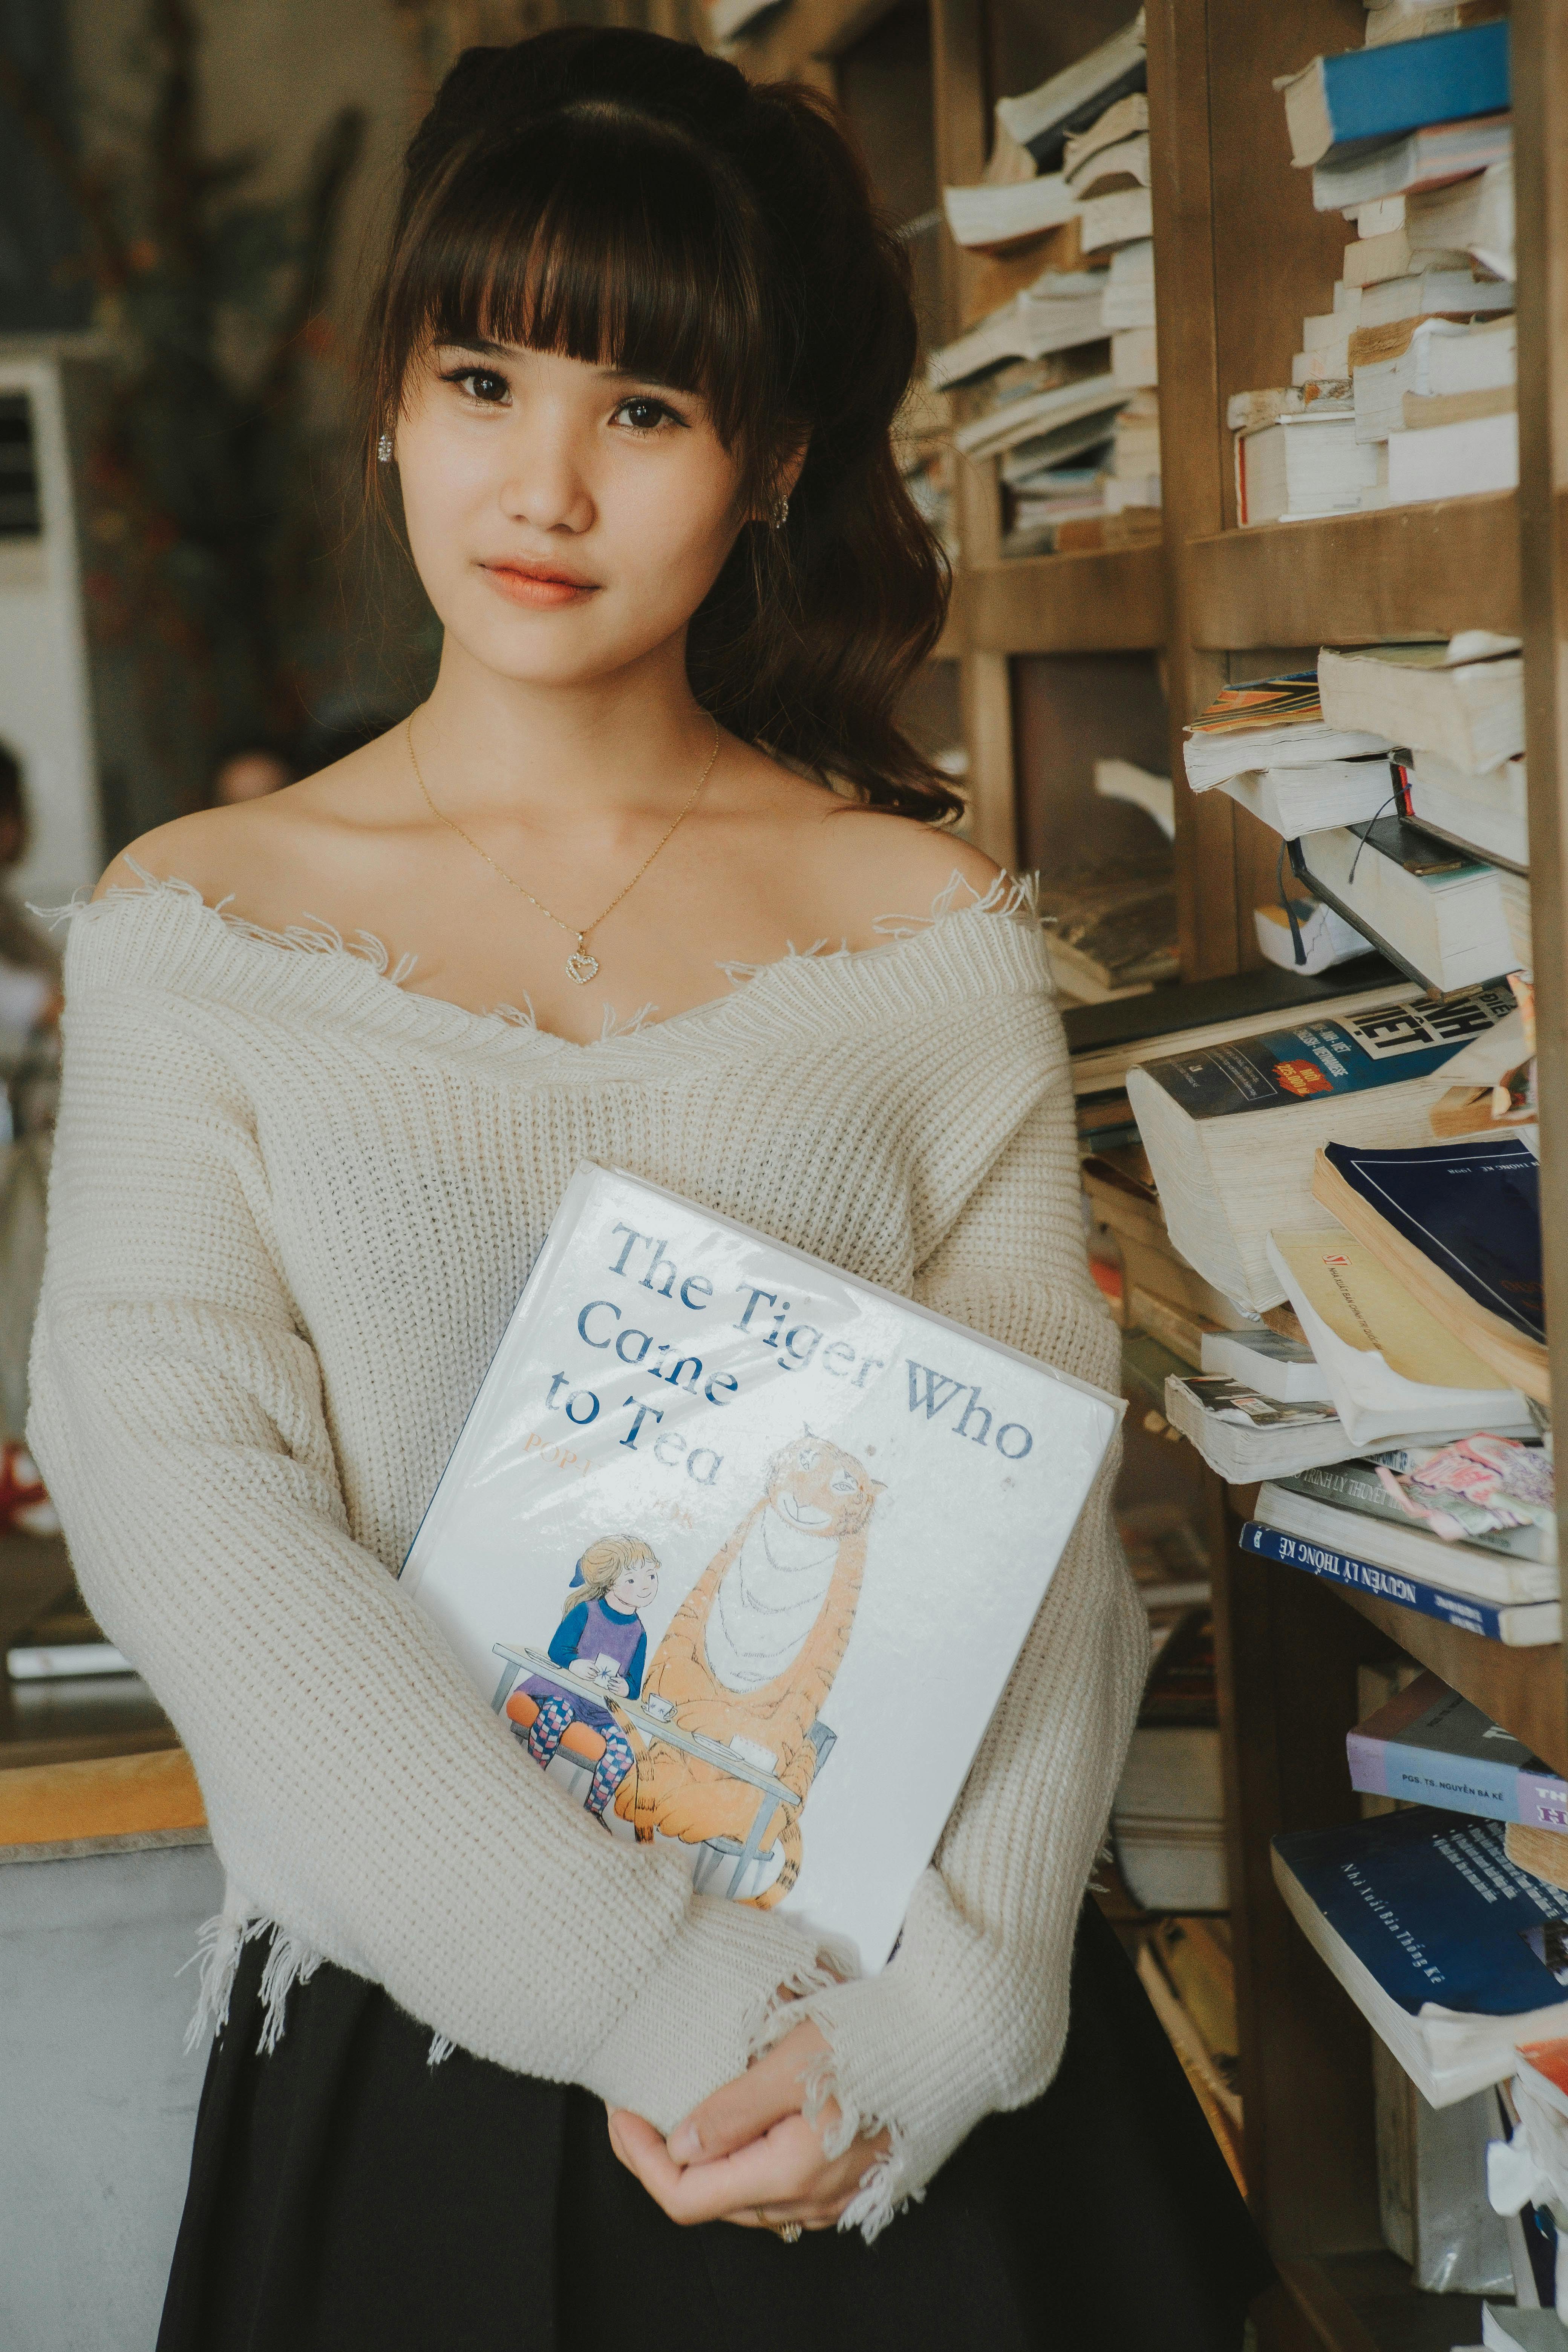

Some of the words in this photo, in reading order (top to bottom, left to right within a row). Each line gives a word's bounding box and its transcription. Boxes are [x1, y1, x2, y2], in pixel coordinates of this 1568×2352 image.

[577, 1300, 738, 1406] Came
[608, 1222, 713, 1310] The
[733, 1283, 884, 1389] Tiger
[905, 1359, 1033, 1459] Who
[545, 1371, 600, 1424] to
[619, 1396, 724, 1485] Tea
[1279, 1537, 1296, 1559] KÊ
[1297, 1544, 1340, 1575] THỐNG
[1342, 1559, 1359, 1583] LÝ
[1361, 1565, 1416, 1604] NGUYÊN
[1402, 1774, 1421, 1784] PGS.
[1341, 1864, 1366, 1886] Nhà
[1380, 1911, 1399, 1931] Bản
[1396, 1930, 1428, 1967] Thống
[1423, 1966, 1446, 1984] Kê
